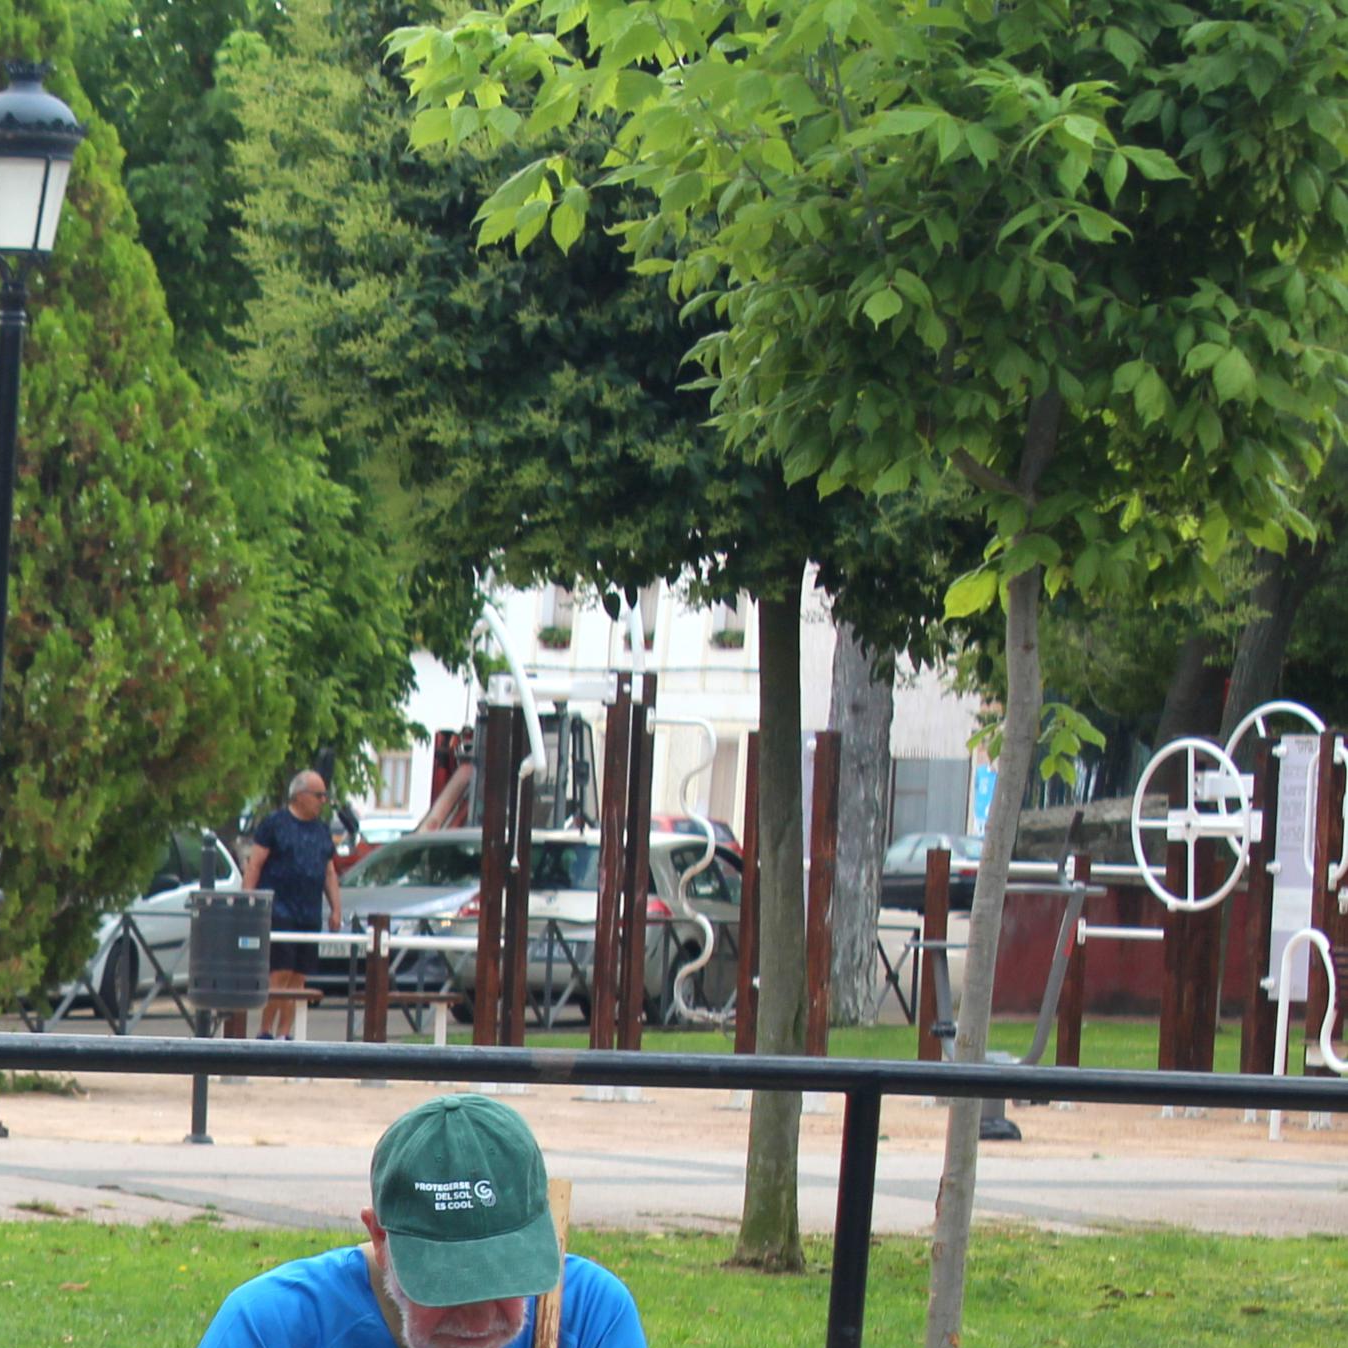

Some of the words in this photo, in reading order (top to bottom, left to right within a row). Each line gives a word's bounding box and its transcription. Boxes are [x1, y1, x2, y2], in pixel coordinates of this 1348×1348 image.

[415, 1181, 471, 1192] PROTEGERSE
[435, 1192, 452, 1201] DEL
[453, 1191, 472, 1200] SOL
[435, 1202, 446, 1211] ES
[447, 1200, 474, 1210] COOL
